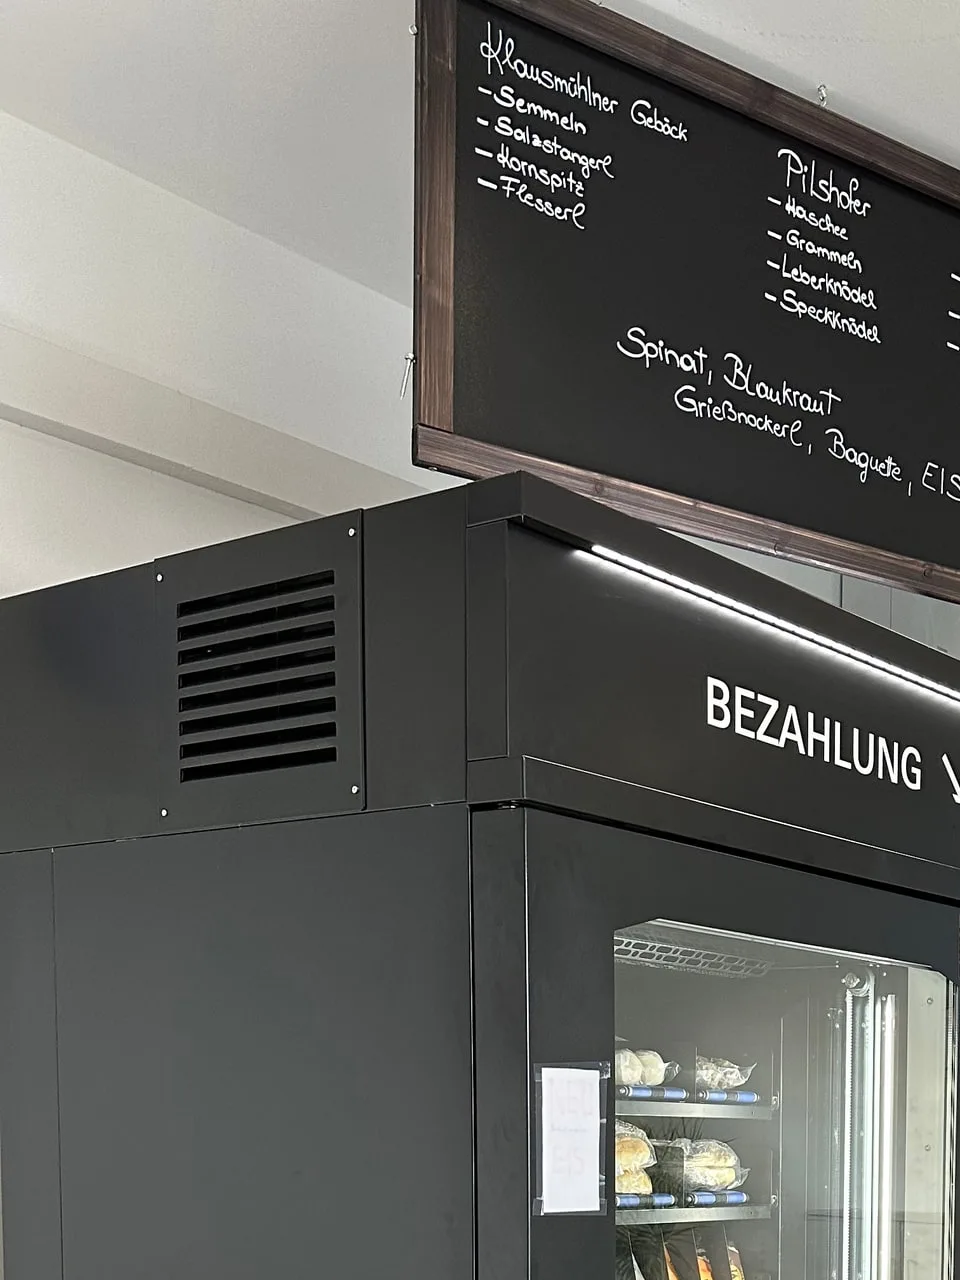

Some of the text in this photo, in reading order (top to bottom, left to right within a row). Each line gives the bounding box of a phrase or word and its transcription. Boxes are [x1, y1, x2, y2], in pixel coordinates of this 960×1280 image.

[480, 21, 688, 141] Klausmühlner Gebäck
[777, 148, 872, 216] Pilshofer
[724, 353, 842, 416] Blaukraut
[706, 675, 922, 791] BEZAHLUNG
